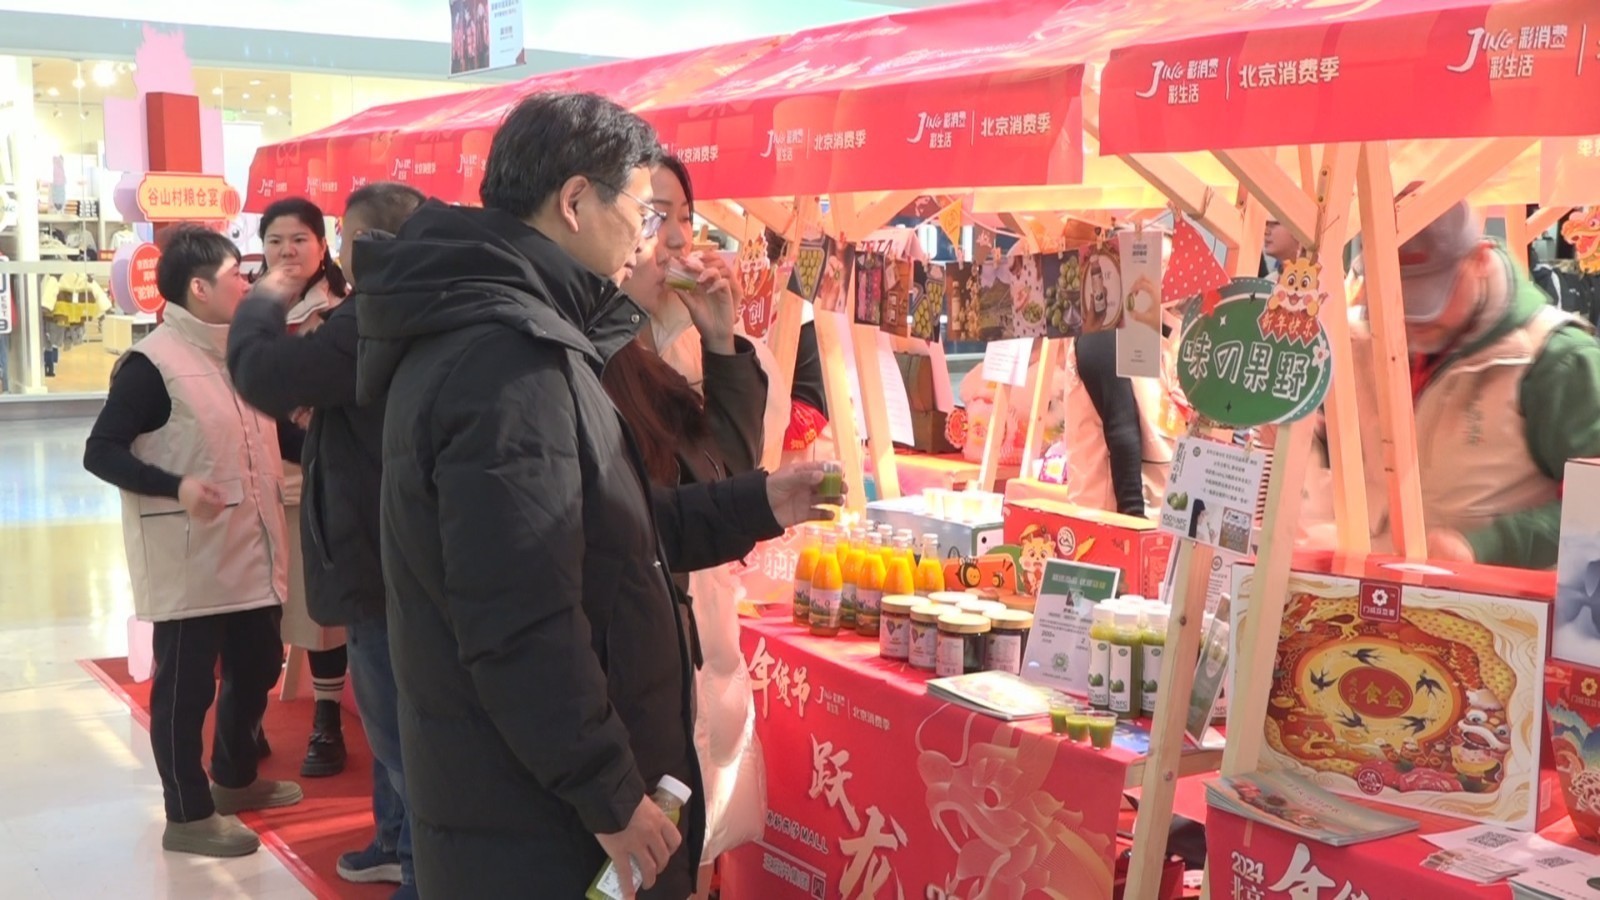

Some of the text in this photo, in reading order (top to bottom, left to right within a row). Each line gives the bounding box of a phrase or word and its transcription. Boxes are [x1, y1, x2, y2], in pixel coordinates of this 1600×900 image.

[1238, 55, 1341, 89] 北京消费季
[1489, 50, 1534, 79] 彩生活
[1167, 81, 1200, 105] 彩生活
[980, 111, 1051, 138] 北京消费季
[813, 128, 867, 152] 北京消费季
[147, 186, 219, 208] 谷山村粮仓宴
[1261, 311, 1315, 338] 新年快乐
[748, 636, 811, 719] 年货节
[1231, 851, 1265, 884] 2024
